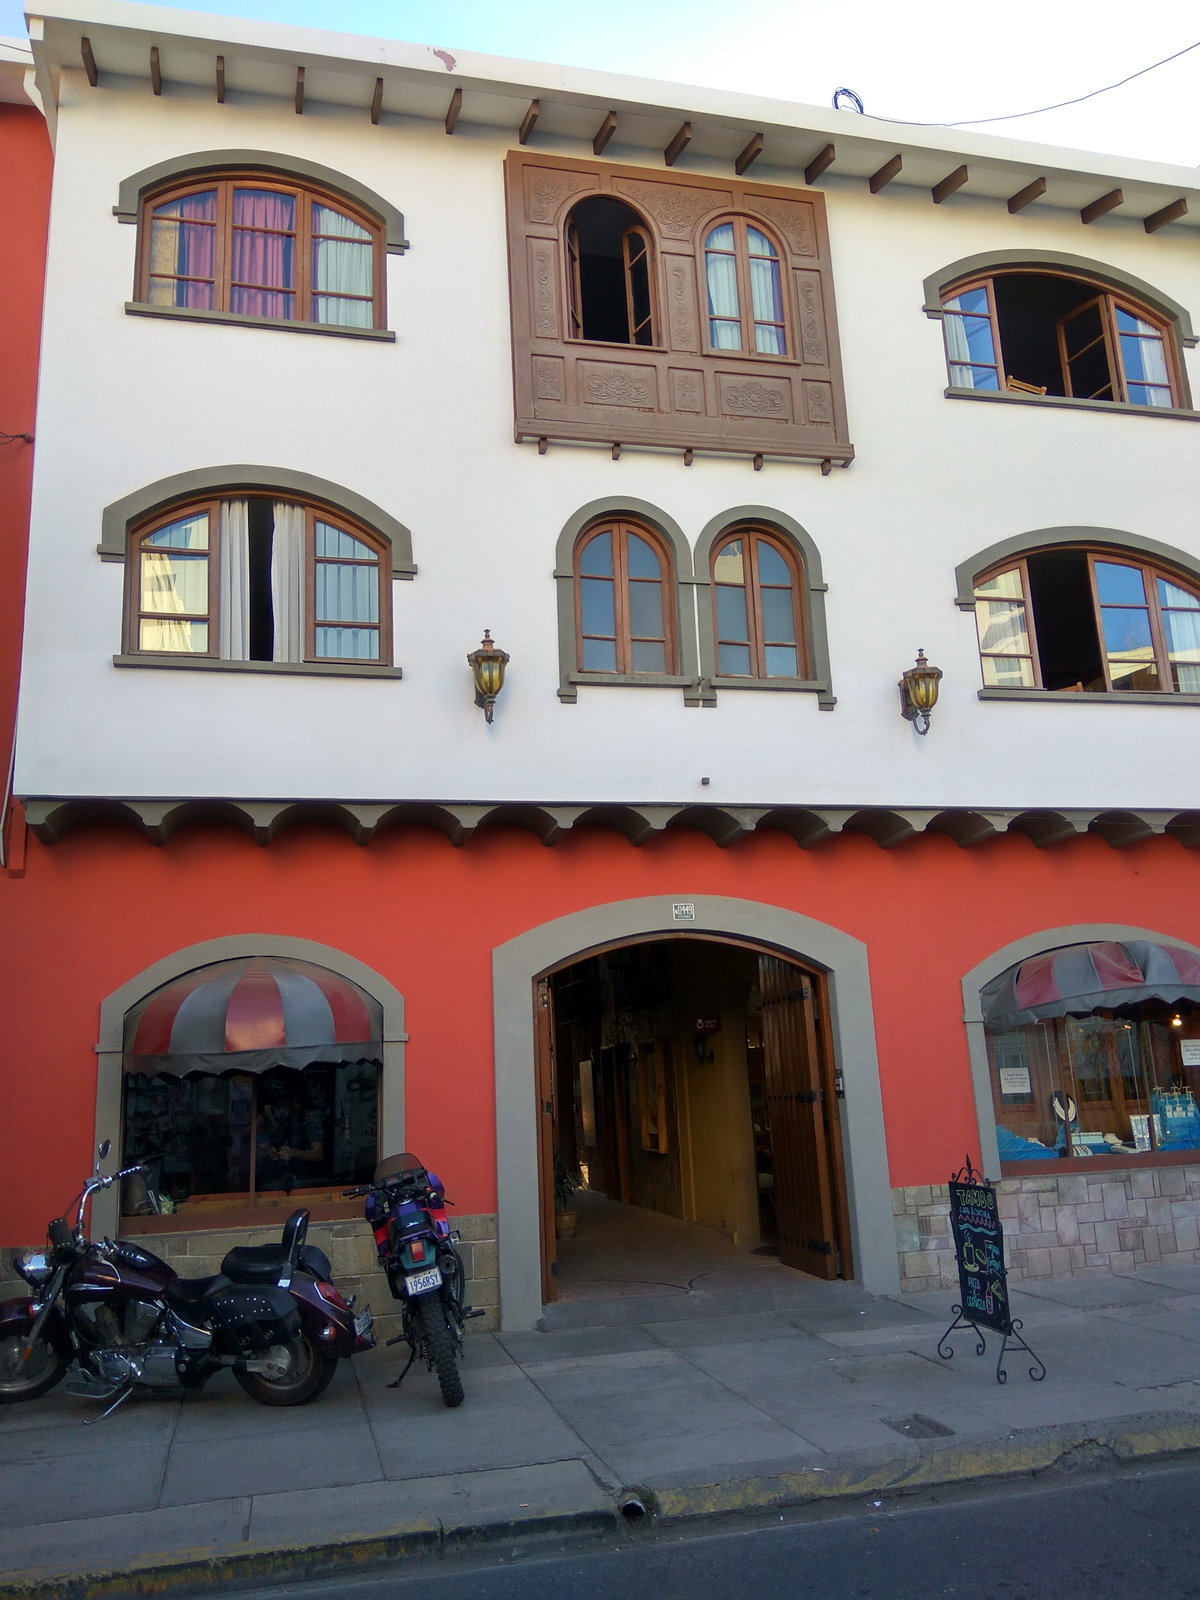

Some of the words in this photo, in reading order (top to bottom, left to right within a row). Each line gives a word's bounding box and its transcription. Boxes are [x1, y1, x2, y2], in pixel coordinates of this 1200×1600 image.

[956, 1189, 994, 1210] TAMBO
[409, 1272, 440, 1292] 1956RSY
[967, 1276, 981, 1289] PIZZA
[966, 1296, 986, 1311] CERVEZA
